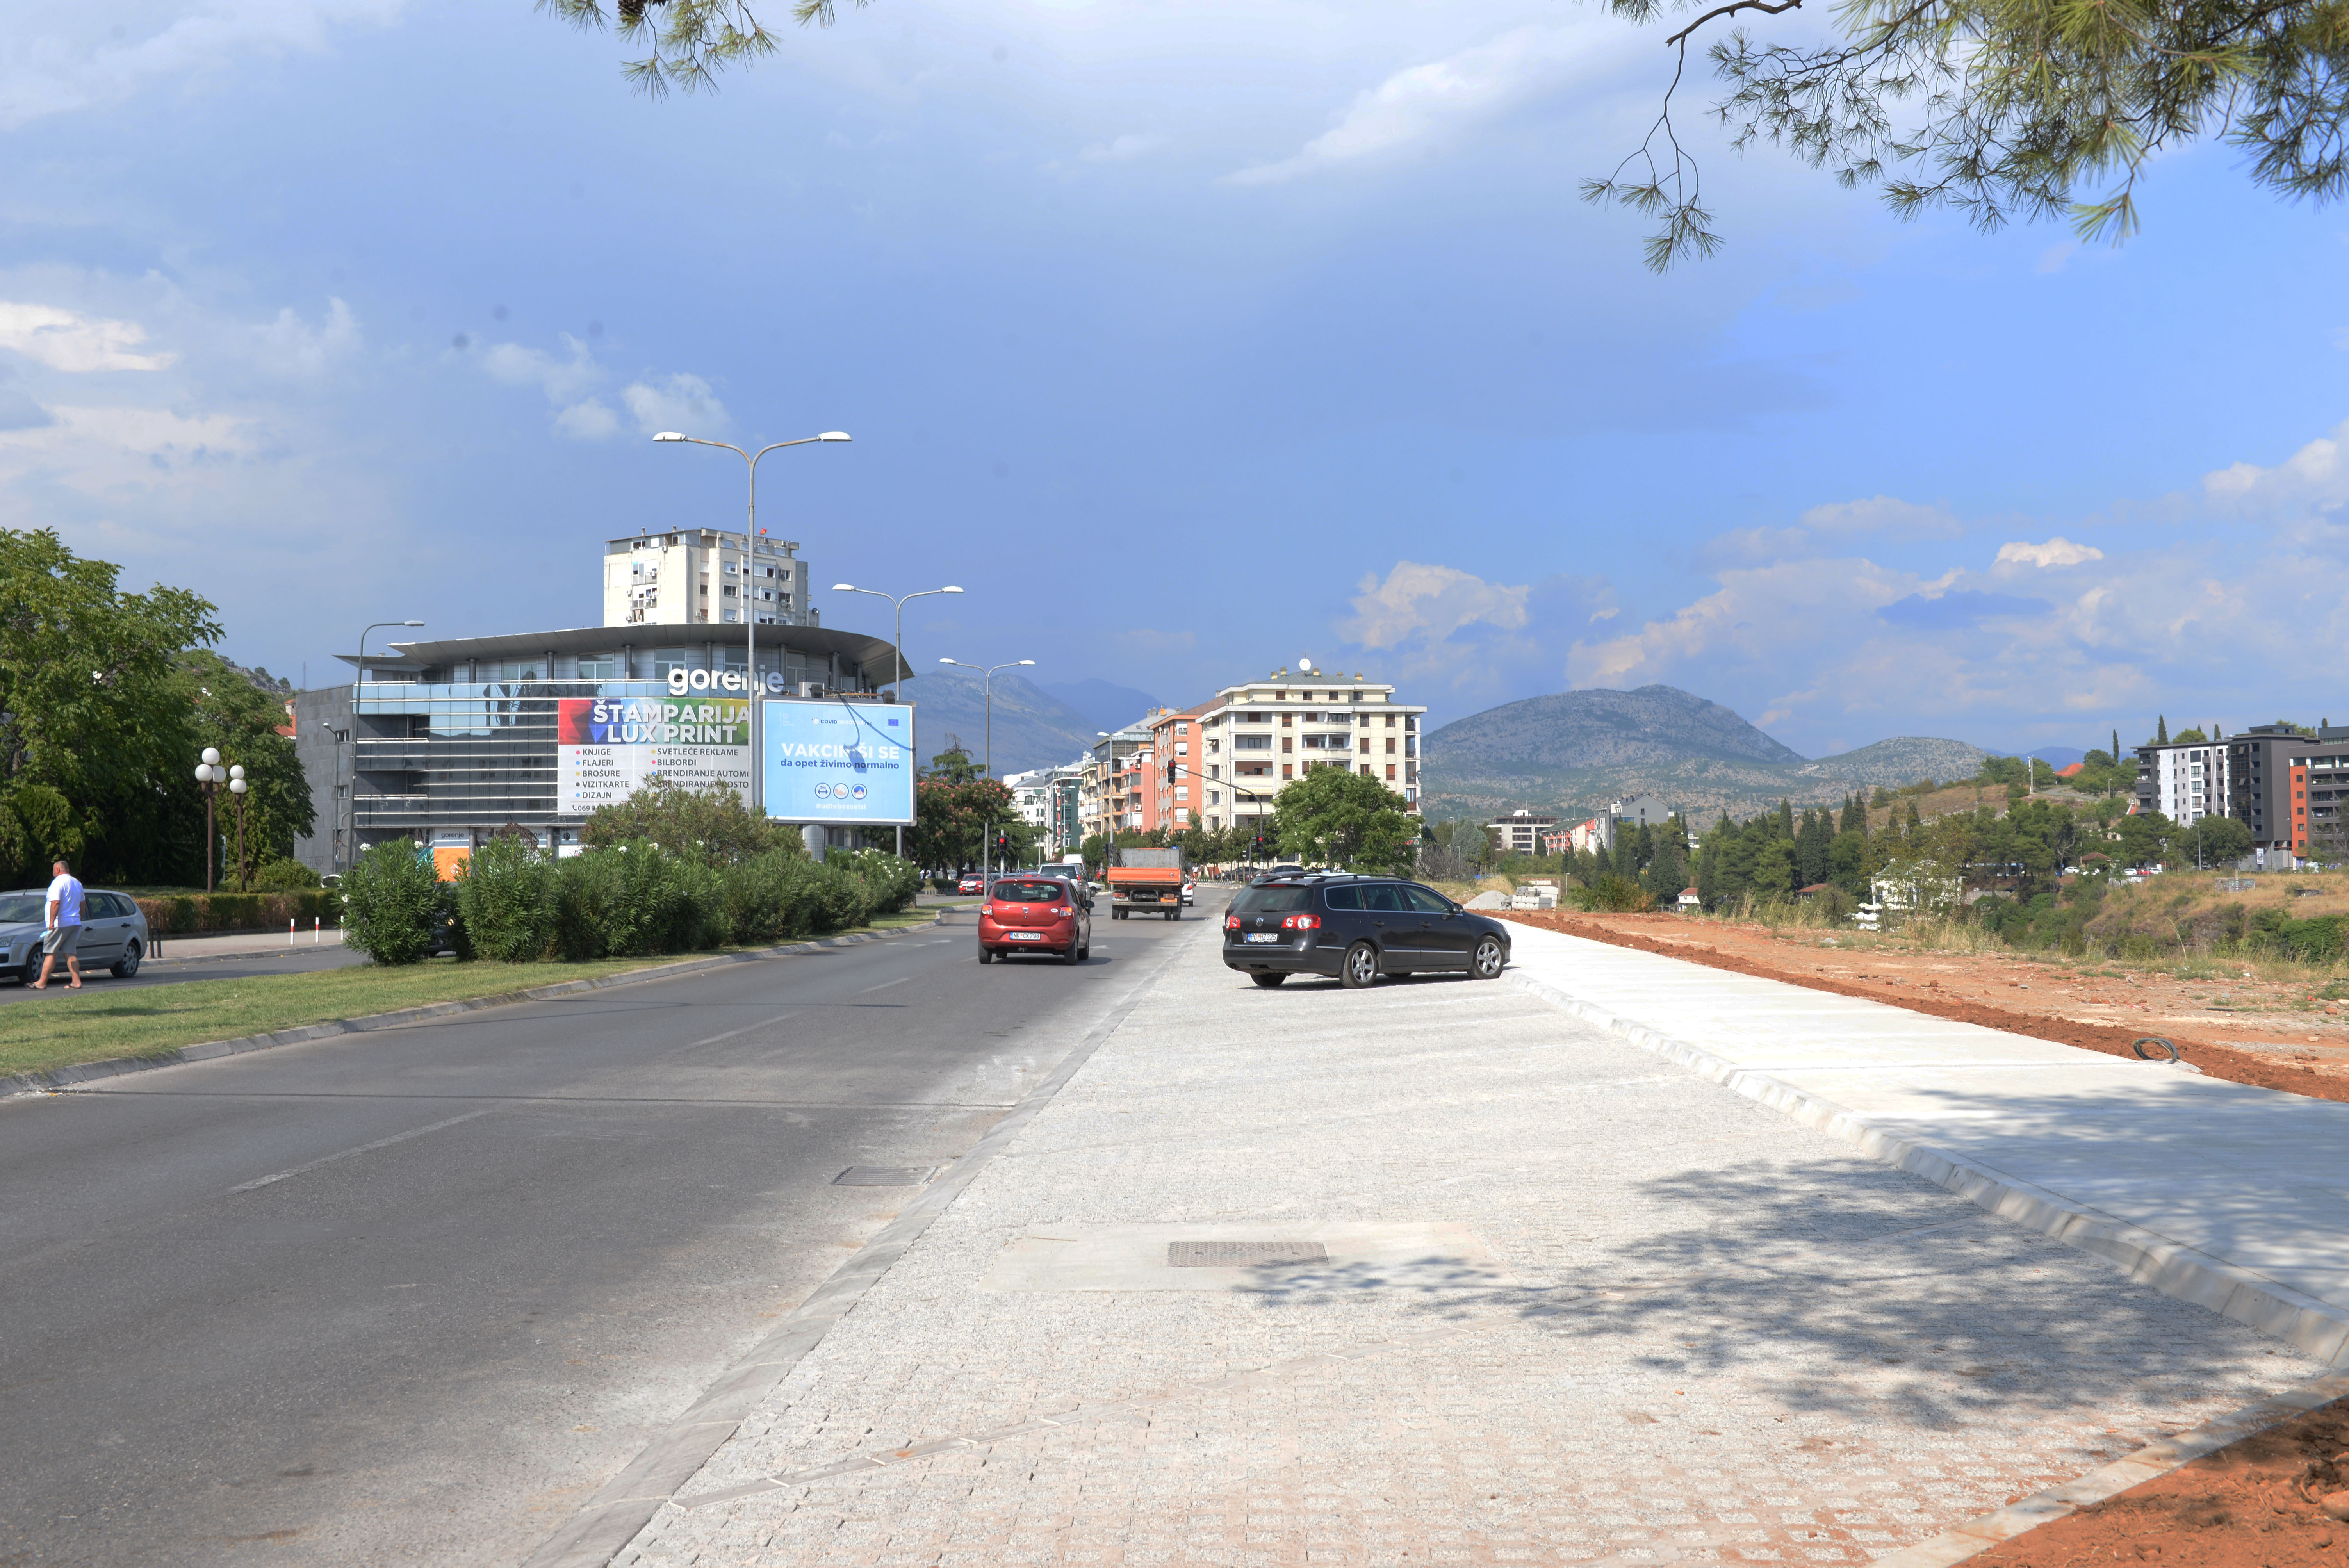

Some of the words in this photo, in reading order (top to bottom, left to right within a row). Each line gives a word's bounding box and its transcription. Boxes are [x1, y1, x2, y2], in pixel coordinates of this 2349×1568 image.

[668, 665, 784, 696] gorenje
[593, 700, 749, 724] ŠTAMPARIJA
[608, 725, 656, 743] LUX
[664, 725, 737, 743] PRINT
[657, 747, 698, 755] SVETLEĆE
[781, 742, 873, 759] VAKCINIŠI
[879, 746, 900, 759] SE
[795, 760, 817, 768] opet
[820, 760, 852, 768] živimo
[582, 769, 620, 777] BROŠURE
